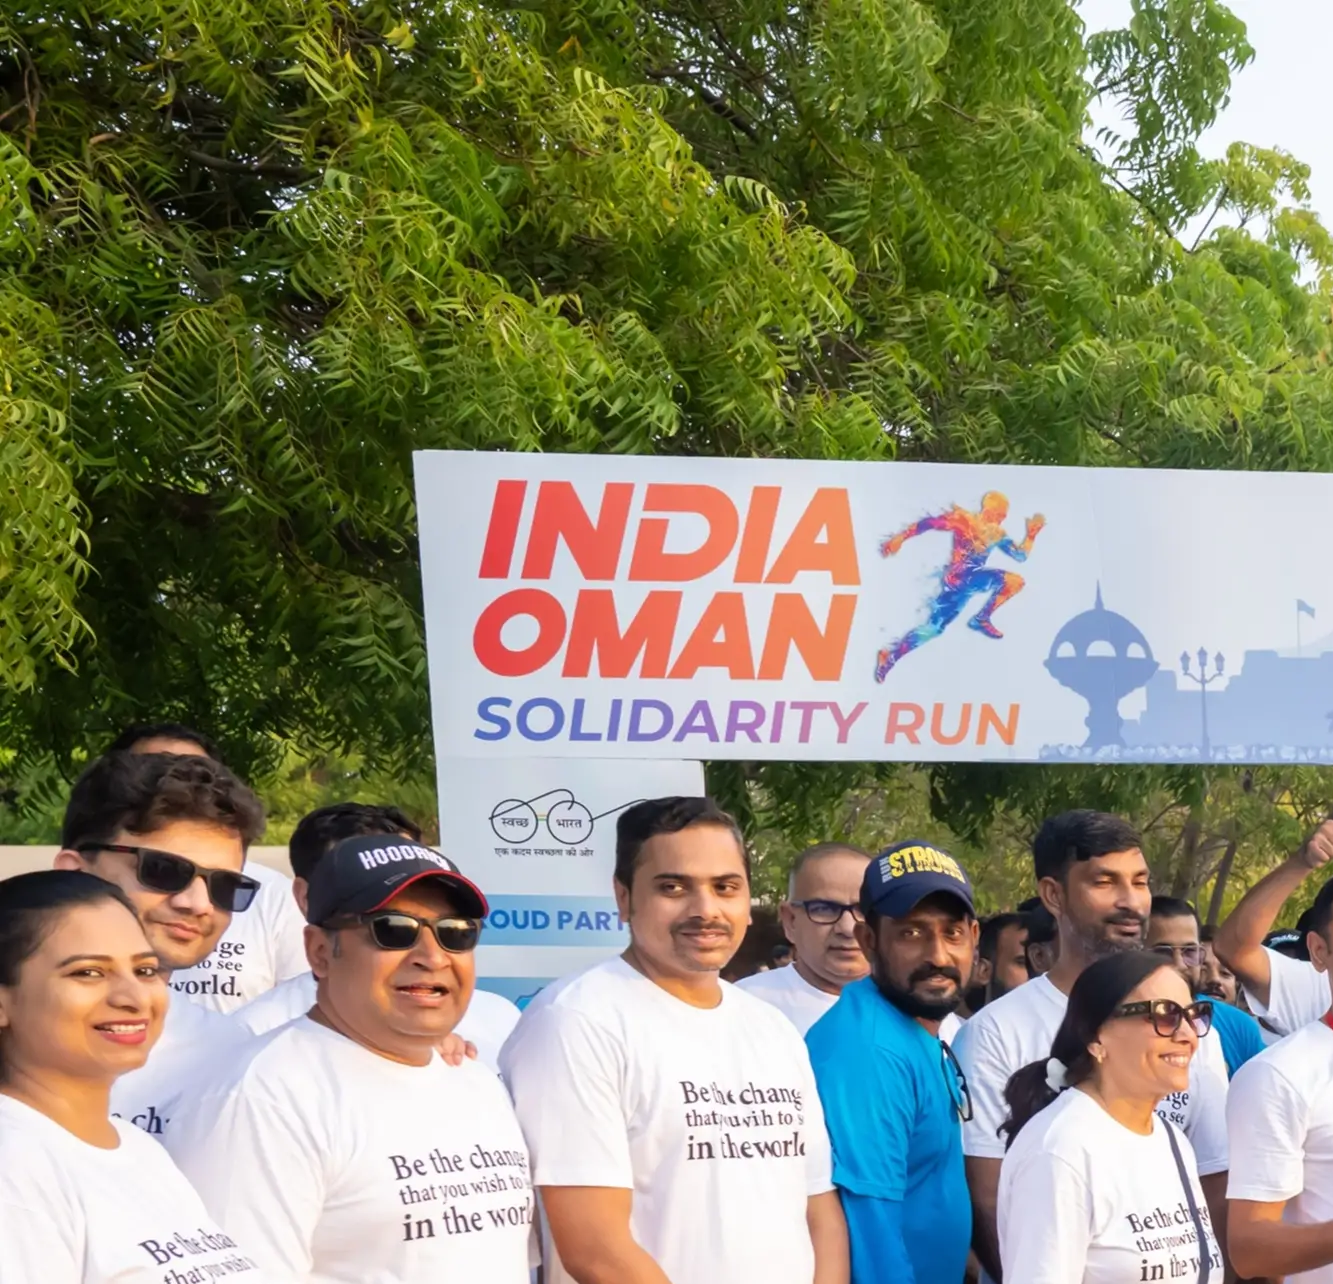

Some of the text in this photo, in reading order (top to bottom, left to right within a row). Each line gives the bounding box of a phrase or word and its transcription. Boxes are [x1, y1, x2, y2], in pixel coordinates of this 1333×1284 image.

[478, 479, 862, 587] INDIA
[472, 587, 858, 682] OMAN
[474, 696, 1020, 746] SOLIDARITY RUN
[501, 817, 529, 828] स्वच्छ
[556, 817, 582, 829] भारत
[484, 909, 624, 931] OUD PART
[217, 960, 243, 972] see
[679, 1081, 711, 1104] Be
[685, 1109, 719, 1127] that
[778, 1111, 793, 1125] to
[687, 1133, 754, 1161] in the
[388, 1149, 464, 1180] Be the
[399, 1184, 437, 1205] that
[439, 1184, 469, 1204] you
[470, 1174, 508, 1193] wish
[509, 1174, 523, 1190] to
[402, 1206, 483, 1241] in the
[1125, 1213, 1155, 1234] Be
[138, 1239, 183, 1265] Be
[1136, 1237, 1164, 1252] that
[1140, 1259, 1164, 1281] in
